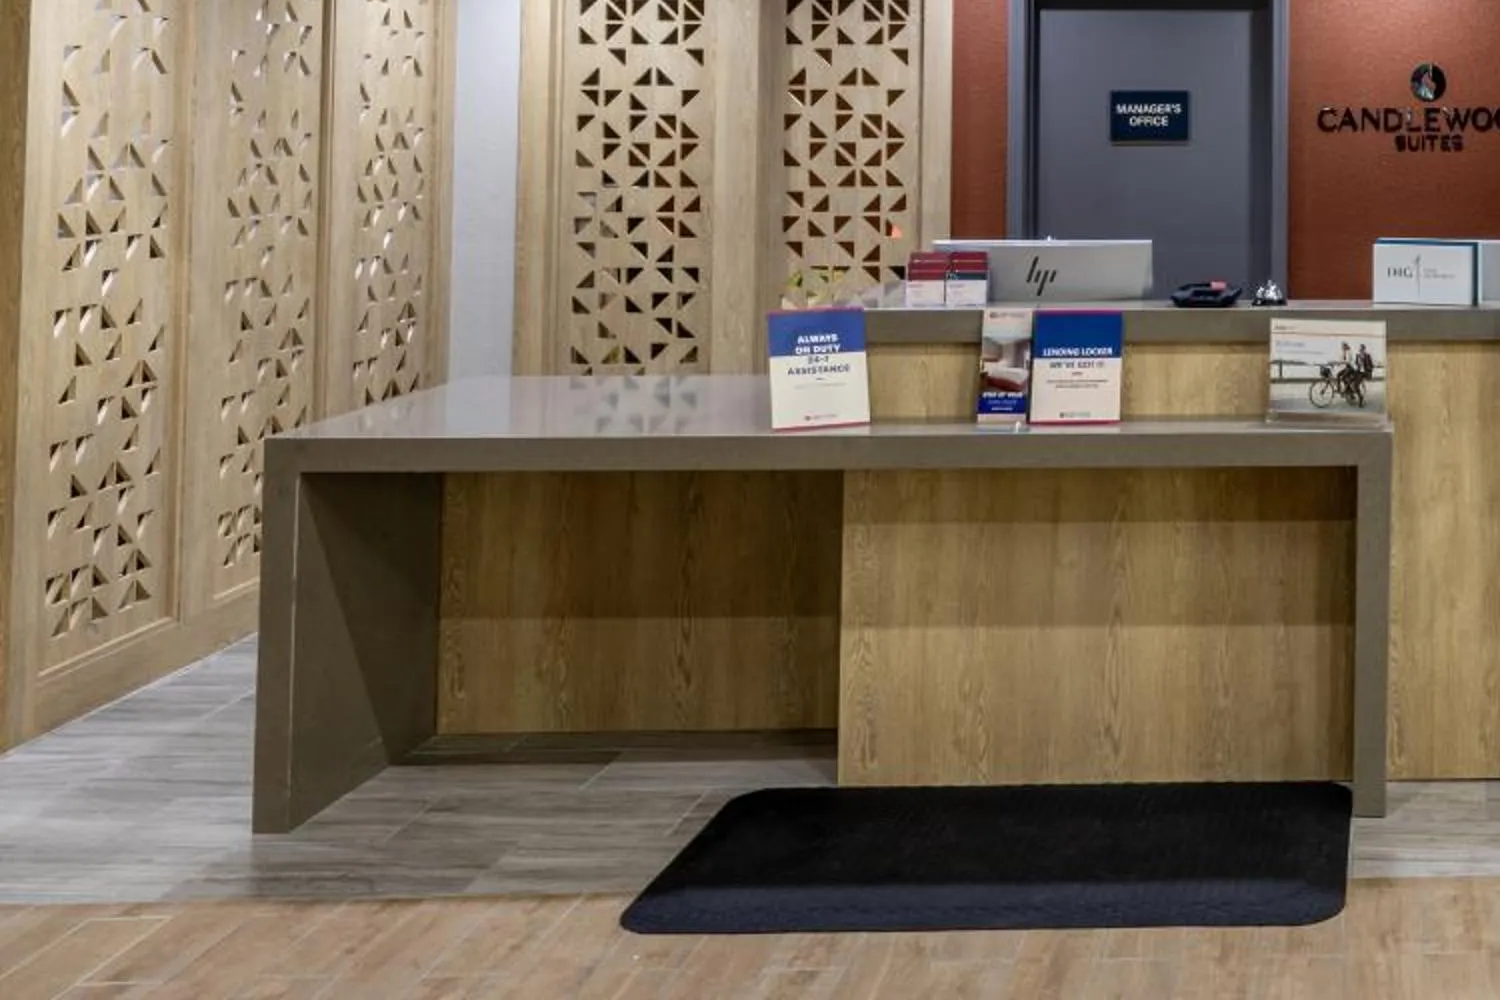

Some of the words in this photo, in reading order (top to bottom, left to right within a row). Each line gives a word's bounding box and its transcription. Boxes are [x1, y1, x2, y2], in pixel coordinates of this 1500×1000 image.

[1116, 103, 1182, 114] MANAGER'S
[1129, 115, 1169, 127] OFFICE
[1394, 135, 1464, 152] SUITES
[797, 333, 839, 345] ALWAYS
[813, 343, 841, 354] DUTY
[1043, 347, 1080, 357] LENDING
[1081, 346, 1113, 356] LOCKER
[787, 364, 852, 376] ASSISTANCE
